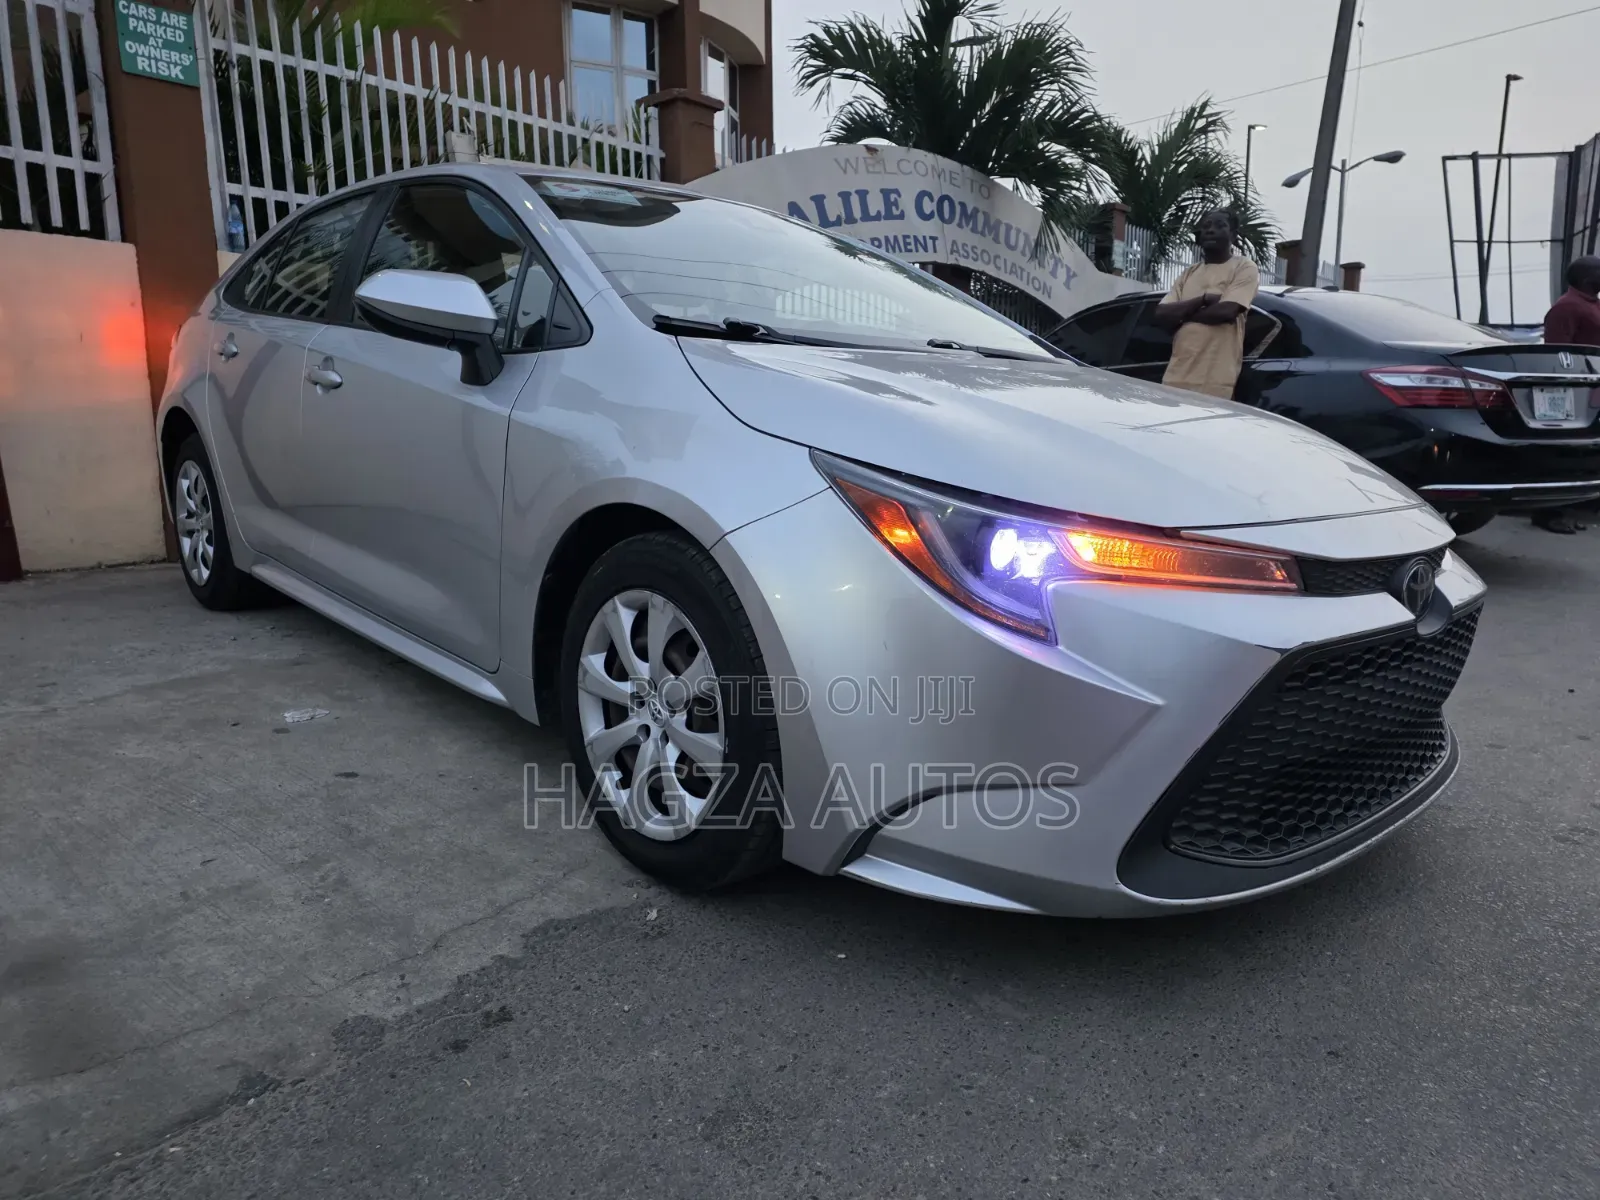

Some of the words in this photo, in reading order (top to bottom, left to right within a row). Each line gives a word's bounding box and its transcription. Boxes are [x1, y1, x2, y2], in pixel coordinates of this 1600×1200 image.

[119, 1, 156, 21] CARS
[161, 11, 188, 29] ARE
[128, 18, 184, 42] PARKED
[149, 37, 164, 48] AT
[137, 56, 184, 80] RISK
[834, 157, 961, 189] WELCOME
[966, 177, 991, 201] TO
[949, 239, 1052, 299] ASSOCIATION
